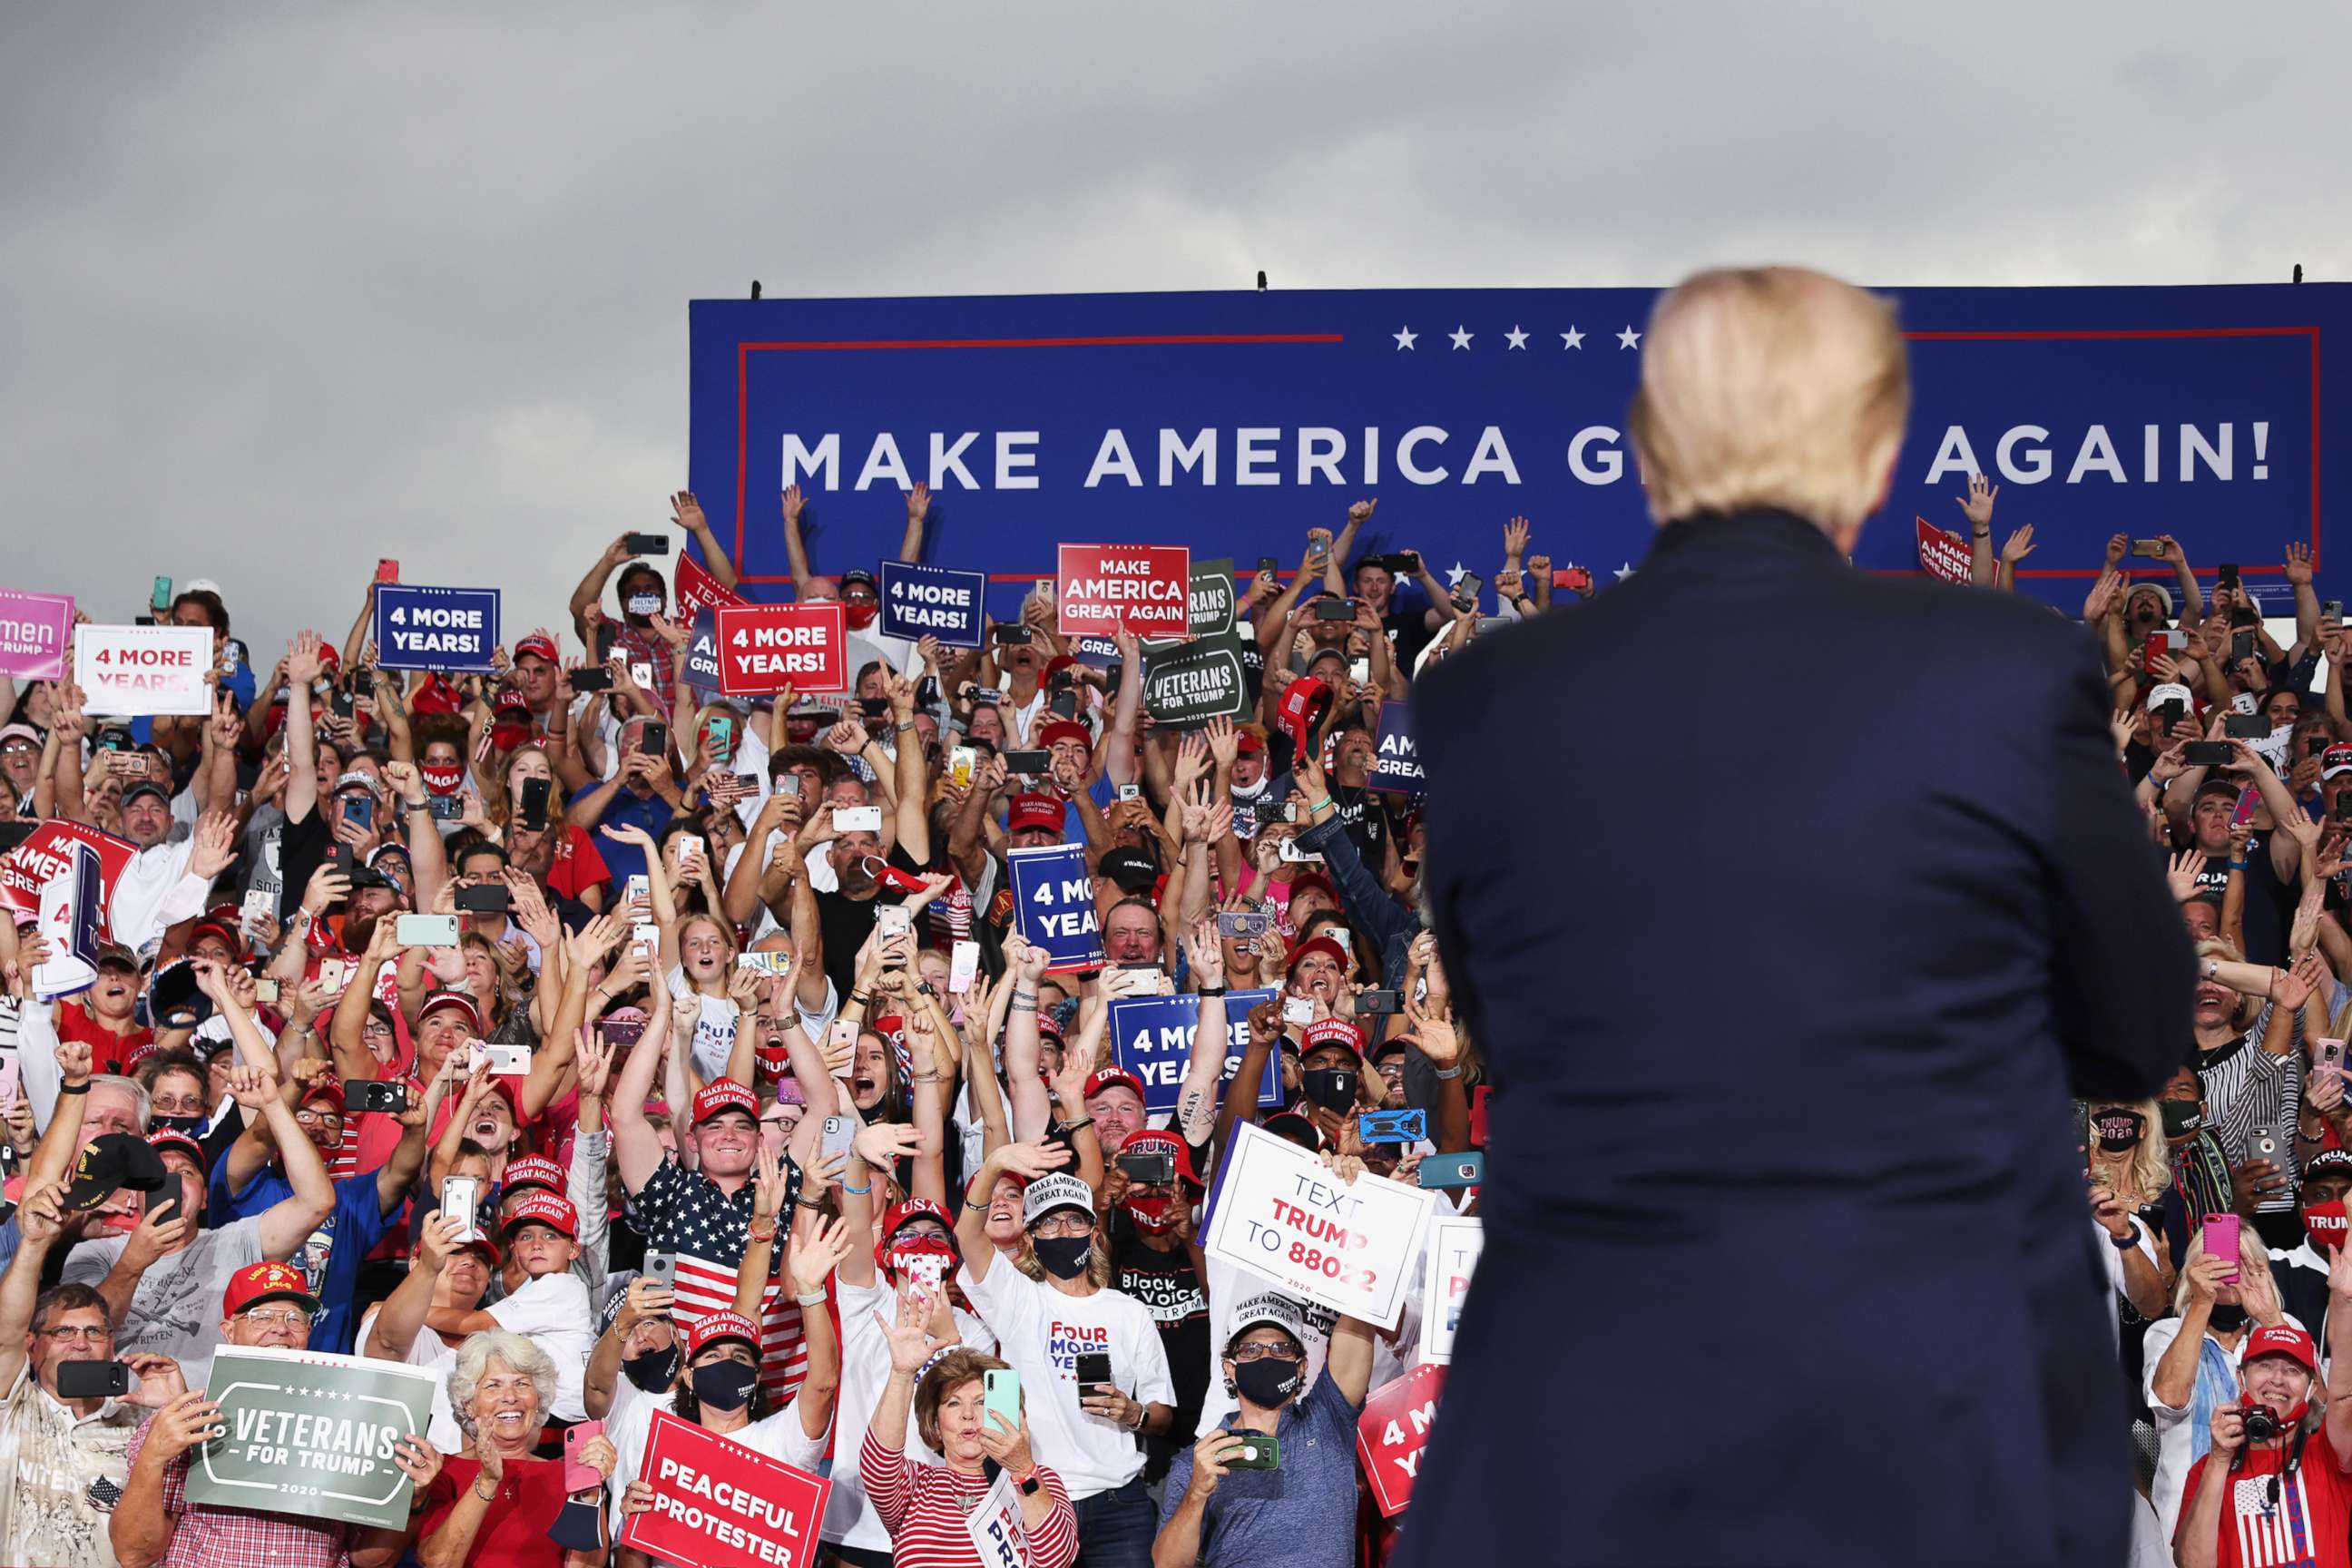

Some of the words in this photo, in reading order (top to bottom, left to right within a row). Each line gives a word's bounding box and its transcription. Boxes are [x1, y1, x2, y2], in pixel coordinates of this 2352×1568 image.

[781, 431, 1040, 491] MAKE
[1083, 426, 1522, 487] AMERICA
[1925, 422, 2269, 485] AGAIN!
[1938, 540, 1972, 566] MAKE
[1100, 560, 1151, 575] MAKE
[891, 582, 904, 599] 4
[908, 583, 971, 606] MORE
[1065, 579, 1183, 601] AMERICA
[390, 607, 406, 625] 4
[413, 608, 483, 629] MORE
[893, 603, 968, 629] YEARS!
[1065, 604, 1122, 619] GREAT
[1129, 605, 1183, 621] AGAIN
[392, 632, 480, 652] YEARS!
[732, 629, 749, 648] 4
[755, 626, 827, 647] MORE
[95, 649, 111, 665] 4
[120, 650, 192, 666] MORE
[1081, 639, 1122, 658] GREA
[690, 657, 719, 677] GRE
[736, 652, 826, 673] YEARS!
[1155, 665, 1232, 699] VETERANS
[500, 694, 527, 709] USA
[1162, 696, 1184, 710] FOR
[1187, 689, 1225, 705] TRUMP
[1187, 713, 1205, 721] 2020
[1377, 759, 1426, 779] GREA
[423, 771, 460, 788] MAGA
[4, 870, 44, 896] GREA
[256, 879, 281, 894] SOC
[1034, 882, 1054, 906] 4
[1062, 878, 1093, 904] MO
[1038, 912, 1100, 937] YEA
[1038, 1011, 1060, 1028] MERICA
[1307, 1022, 1328, 1035] MAKE
[1328, 1021, 1359, 1039] AMERICA
[1309, 1032, 1332, 1044] GREAT
[1333, 1032, 1355, 1046] AGAIN
[1133, 1029, 1152, 1053] 4
[754, 1054, 791, 1073] TRUM
[1096, 1065, 1131, 1082] USA
[699, 1085, 723, 1101] MAKE
[722, 1083, 757, 1102] AMERICA
[704, 1094, 729, 1109] GREAT
[730, 1094, 754, 1110] AGAIN
[2100, 1116, 2133, 1128] TRUMP
[162, 1130, 199, 1149] AMERICA
[2100, 1128, 2133, 1139] 2020
[1127, 1141, 1179, 1155] TRUMP
[505, 1159, 528, 1174] MAKE
[528, 1157, 563, 1176] AMERICA
[508, 1169, 534, 1182] GREAT
[534, 1169, 559, 1183] AGAIN
[1028, 1179, 1052, 1196] MAKE
[1053, 1175, 1089, 1192] AMERICA
[532, 1193, 572, 1214] AMERICA
[1034, 1189, 1060, 1205] GREAT
[1060, 1188, 1087, 1202] AGAIN
[1296, 1173, 1364, 1219] TEXT
[538, 1205, 565, 1220] AGAIN
[901, 1198, 942, 1216] USA
[1131, 1206, 1167, 1228] TRU
[1272, 1198, 1368, 1250] TRUMP
[2308, 1215, 2349, 1230] TRUM
[1248, 1220, 1281, 1251] TO
[893, 1252, 952, 1269] MA
[1122, 1273, 1177, 1291] Black
[1288, 1278, 1311, 1293] 2020
[1142, 1287, 1202, 1306] Voice
[1235, 1297, 1260, 1313] MAKE
[1261, 1296, 1299, 1316] AMERICA
[1162, 1296, 1207, 1318] TRUM
[1239, 1308, 1267, 1322] GREAT
[1269, 1308, 1294, 1325] AGAIN
[694, 1313, 720, 1331] MAKE
[720, 1312, 757, 1334] AMERICA
[700, 1324, 727, 1340] GREAT
[729, 1324, 754, 1339] AGAIN
[1051, 1321, 1109, 1343] FOUR
[1155, 1321, 1180, 1329] 202
[738, 1383, 756, 1393] TRUMP
[1278, 1376, 1297, 1388] TRUMP
[236, 1407, 398, 1460] VETERANS
[1382, 1418, 1406, 1446] 4
[246, 1445, 289, 1465] FOR
[298, 1450, 375, 1476] TRUMP
[19, 1458, 80, 1494] NITED
[279, 1483, 318, 1494] 2020
[659, 1456, 799, 1538] PEACEFUL
[653, 1492, 793, 1568] PROTESTER
